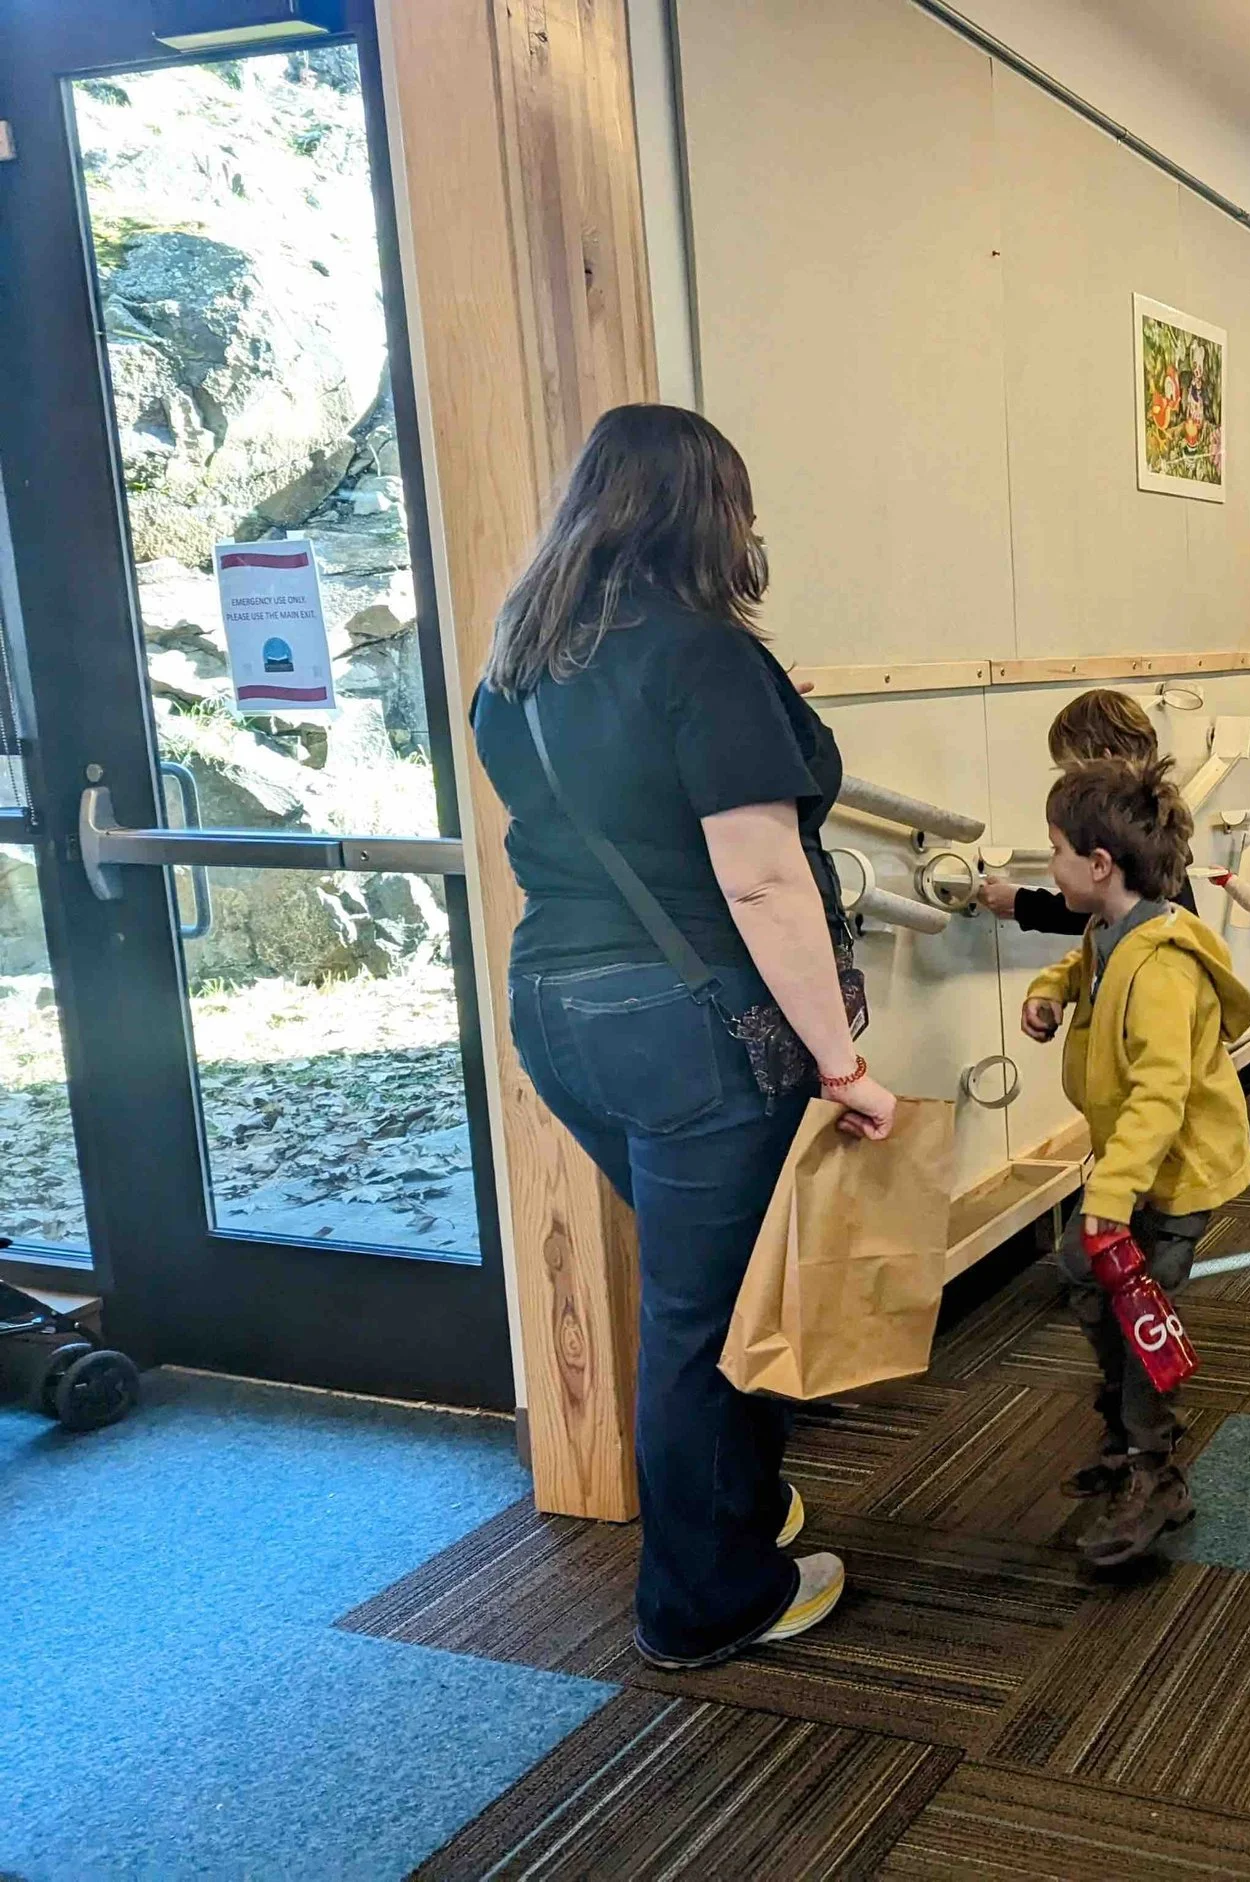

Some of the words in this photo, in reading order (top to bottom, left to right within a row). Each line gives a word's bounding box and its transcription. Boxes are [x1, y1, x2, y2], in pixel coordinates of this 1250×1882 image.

[231, 597, 272, 606] EMERGENCY
[273, 596, 286, 605] USE
[226, 612, 250, 622] PLEASE
[250, 611, 264, 621] USE
[265, 611, 279, 620] THE
[279, 610, 300, 619] MAIN
